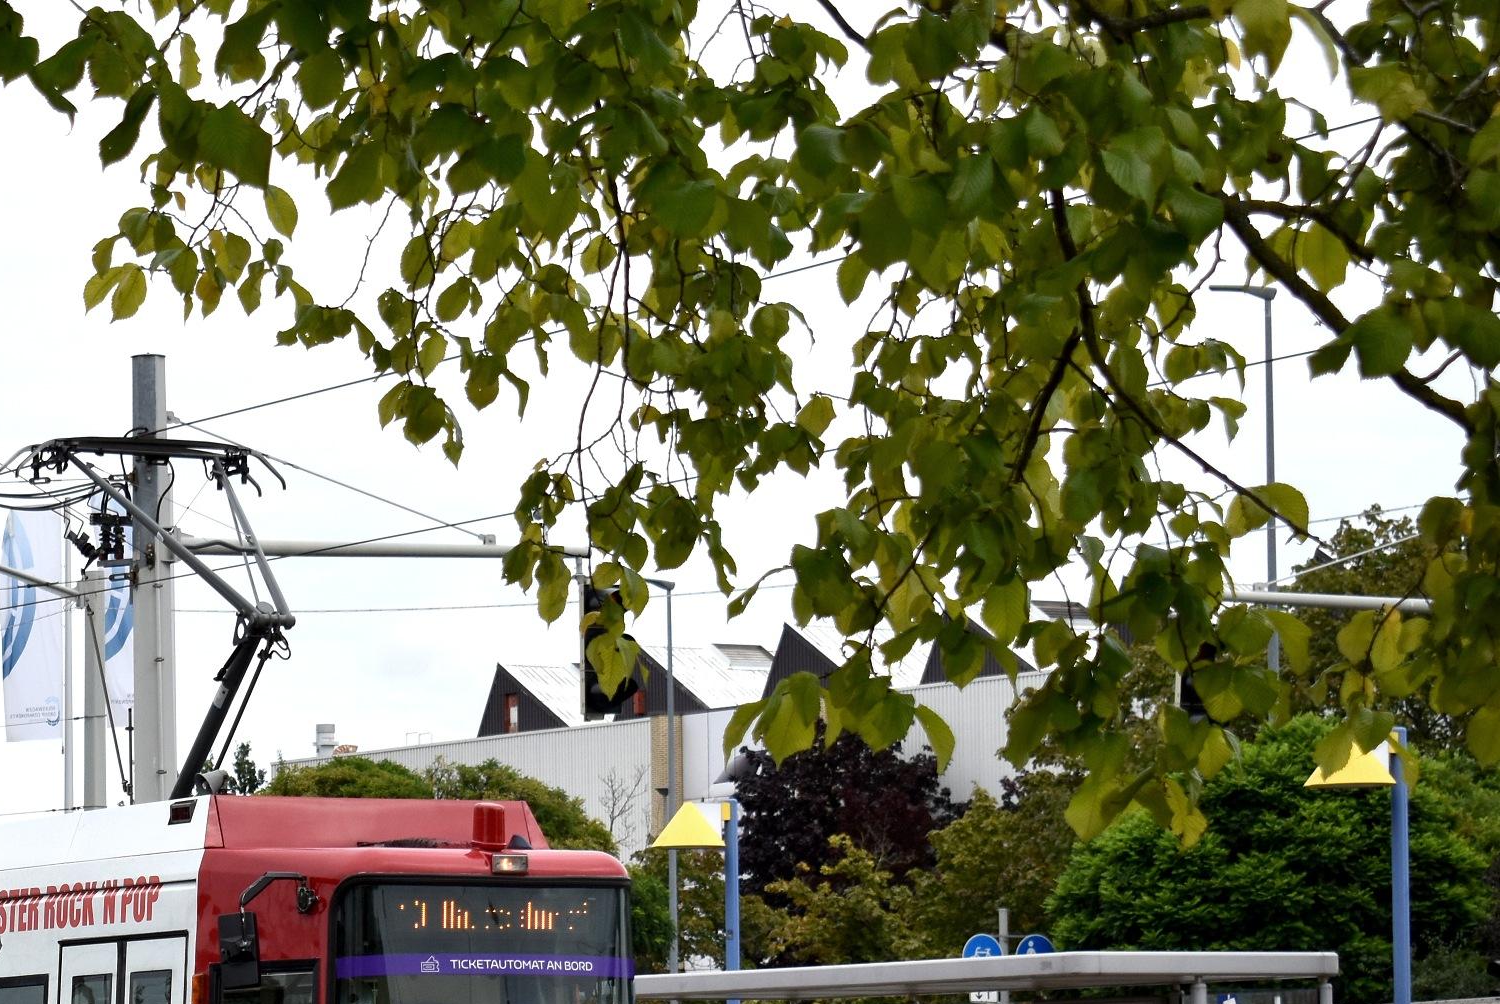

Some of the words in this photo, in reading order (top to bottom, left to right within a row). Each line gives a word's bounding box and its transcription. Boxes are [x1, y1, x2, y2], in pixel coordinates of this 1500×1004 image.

[43, 881, 98, 929] ROCK
[120, 876, 162, 924] POP
[450, 959, 544, 970] TICKETAUTOMAT
[546, 961, 562, 971] AN
[564, 961, 593, 971] BORD
